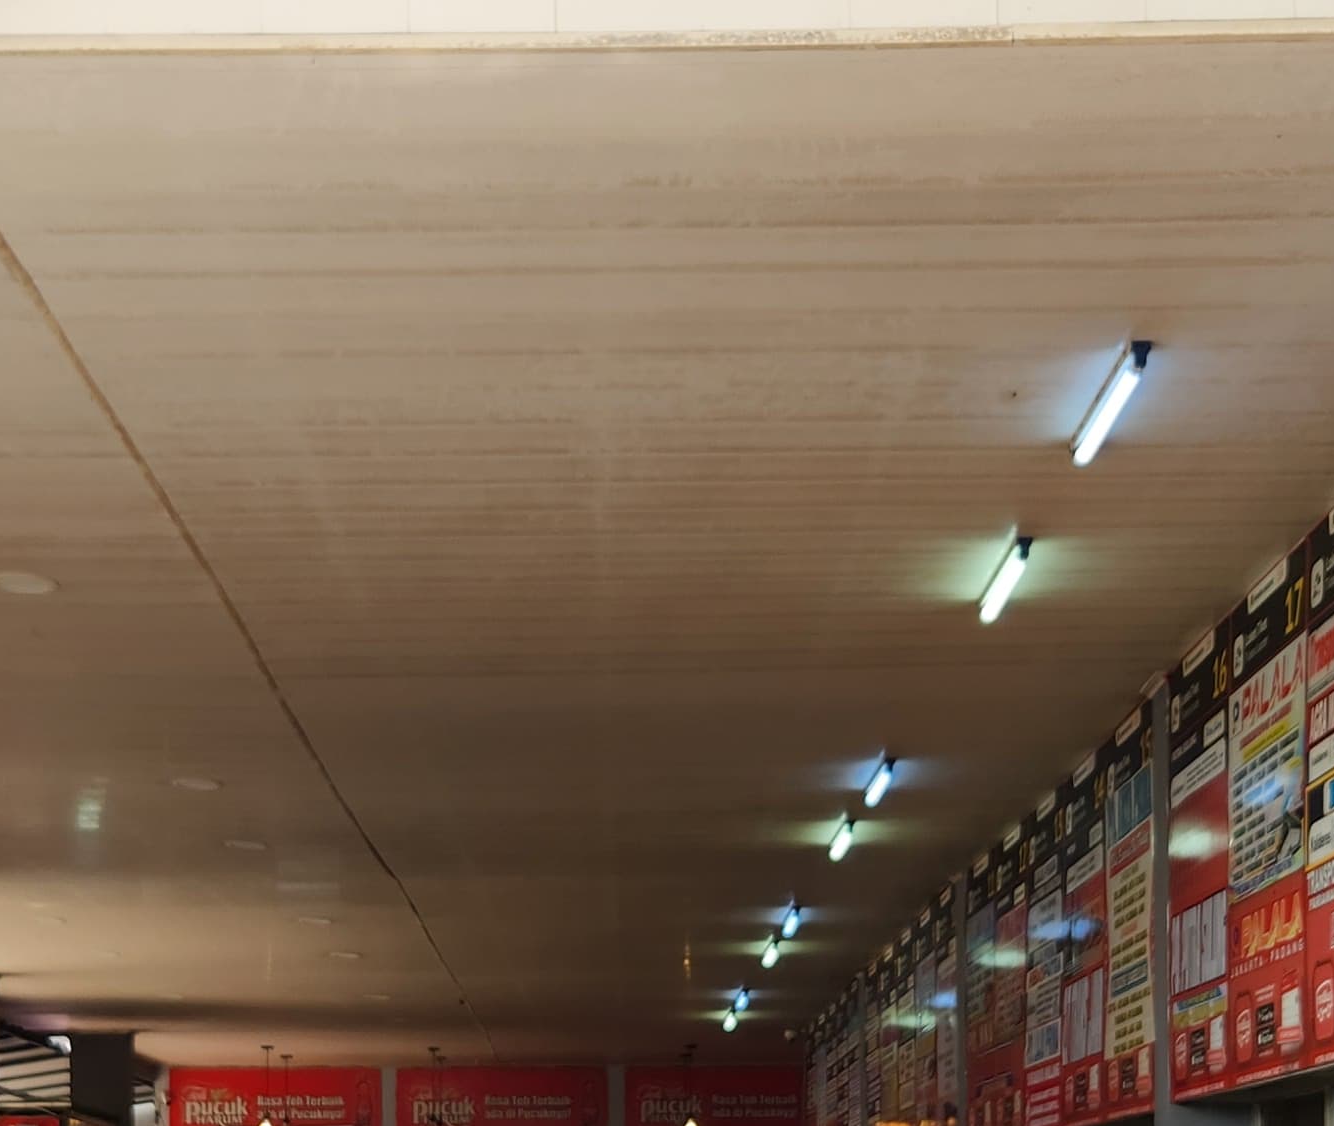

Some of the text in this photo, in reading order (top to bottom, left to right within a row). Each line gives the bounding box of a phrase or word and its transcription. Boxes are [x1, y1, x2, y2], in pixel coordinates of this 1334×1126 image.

[1284, 576, 1305, 636] 17
[1212, 648, 1229, 700] 16
[1269, 937, 1304, 963] PADANG
